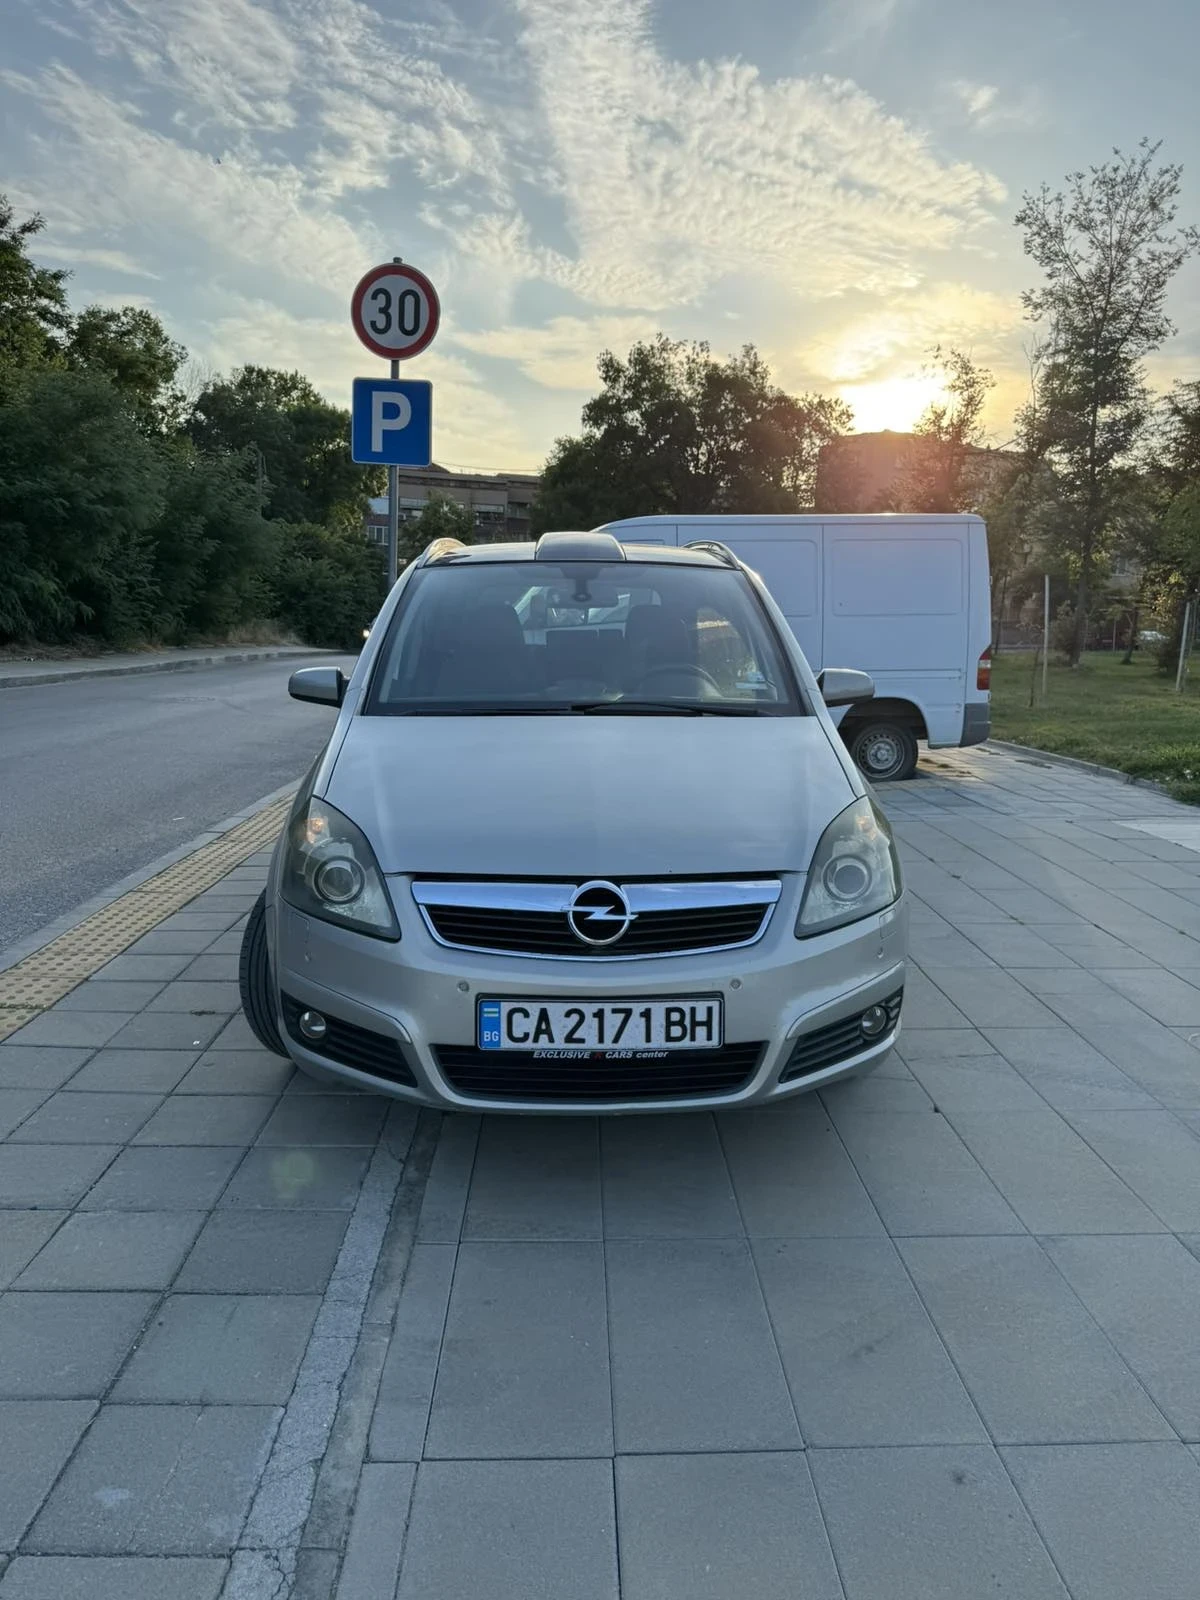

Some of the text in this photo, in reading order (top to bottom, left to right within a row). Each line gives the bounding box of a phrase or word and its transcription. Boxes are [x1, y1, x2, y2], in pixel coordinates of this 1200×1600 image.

[370, 287, 420, 336] 30
[371, 391, 412, 453] P
[483, 1030, 500, 1042] BG
[506, 1006, 555, 1043] CA
[563, 1007, 652, 1044] 2171
[532, 1050, 669, 1059] EXCLUSIVE CARS center
